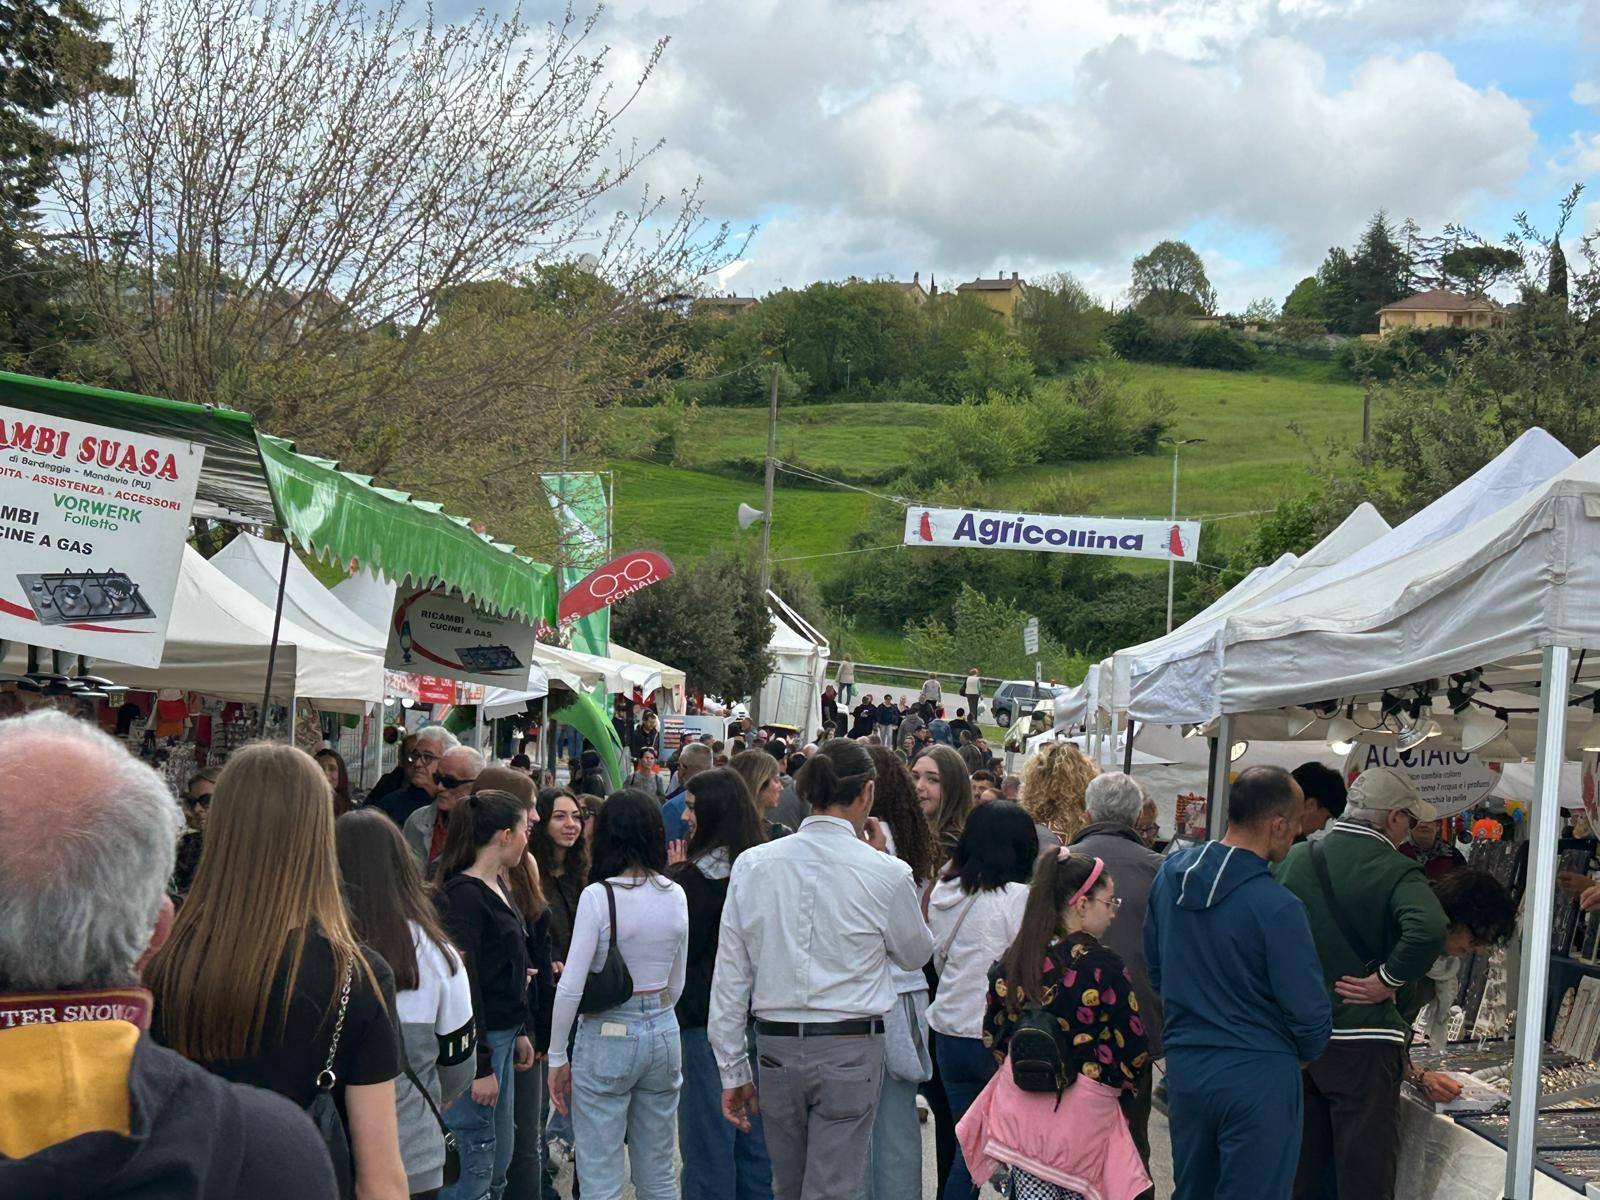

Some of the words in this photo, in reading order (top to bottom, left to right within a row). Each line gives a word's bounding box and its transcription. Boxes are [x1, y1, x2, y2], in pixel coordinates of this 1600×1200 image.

[9, 455, 18, 463] di
[131, 478, 151, 491] (PU)
[77, 436, 179, 482] SUASA
[32, 473, 105, 495] ASSISTENZA
[114, 490, 181, 511] ACCESSORI
[53, 492, 142, 524] VORWERK
[64, 511, 119, 532] Folletto
[0, 525, 35, 544] INE
[39, 534, 51, 547] A
[57, 538, 93, 555] GAS
[953, 513, 1144, 551] Agricollina
[420, 609, 465, 625] RICAMBI
[429, 622, 463, 634] CUCINE
[465, 627, 472, 635] A
[473, 629, 492, 639] GAS
[0, 1007, 56, 1026] TER
